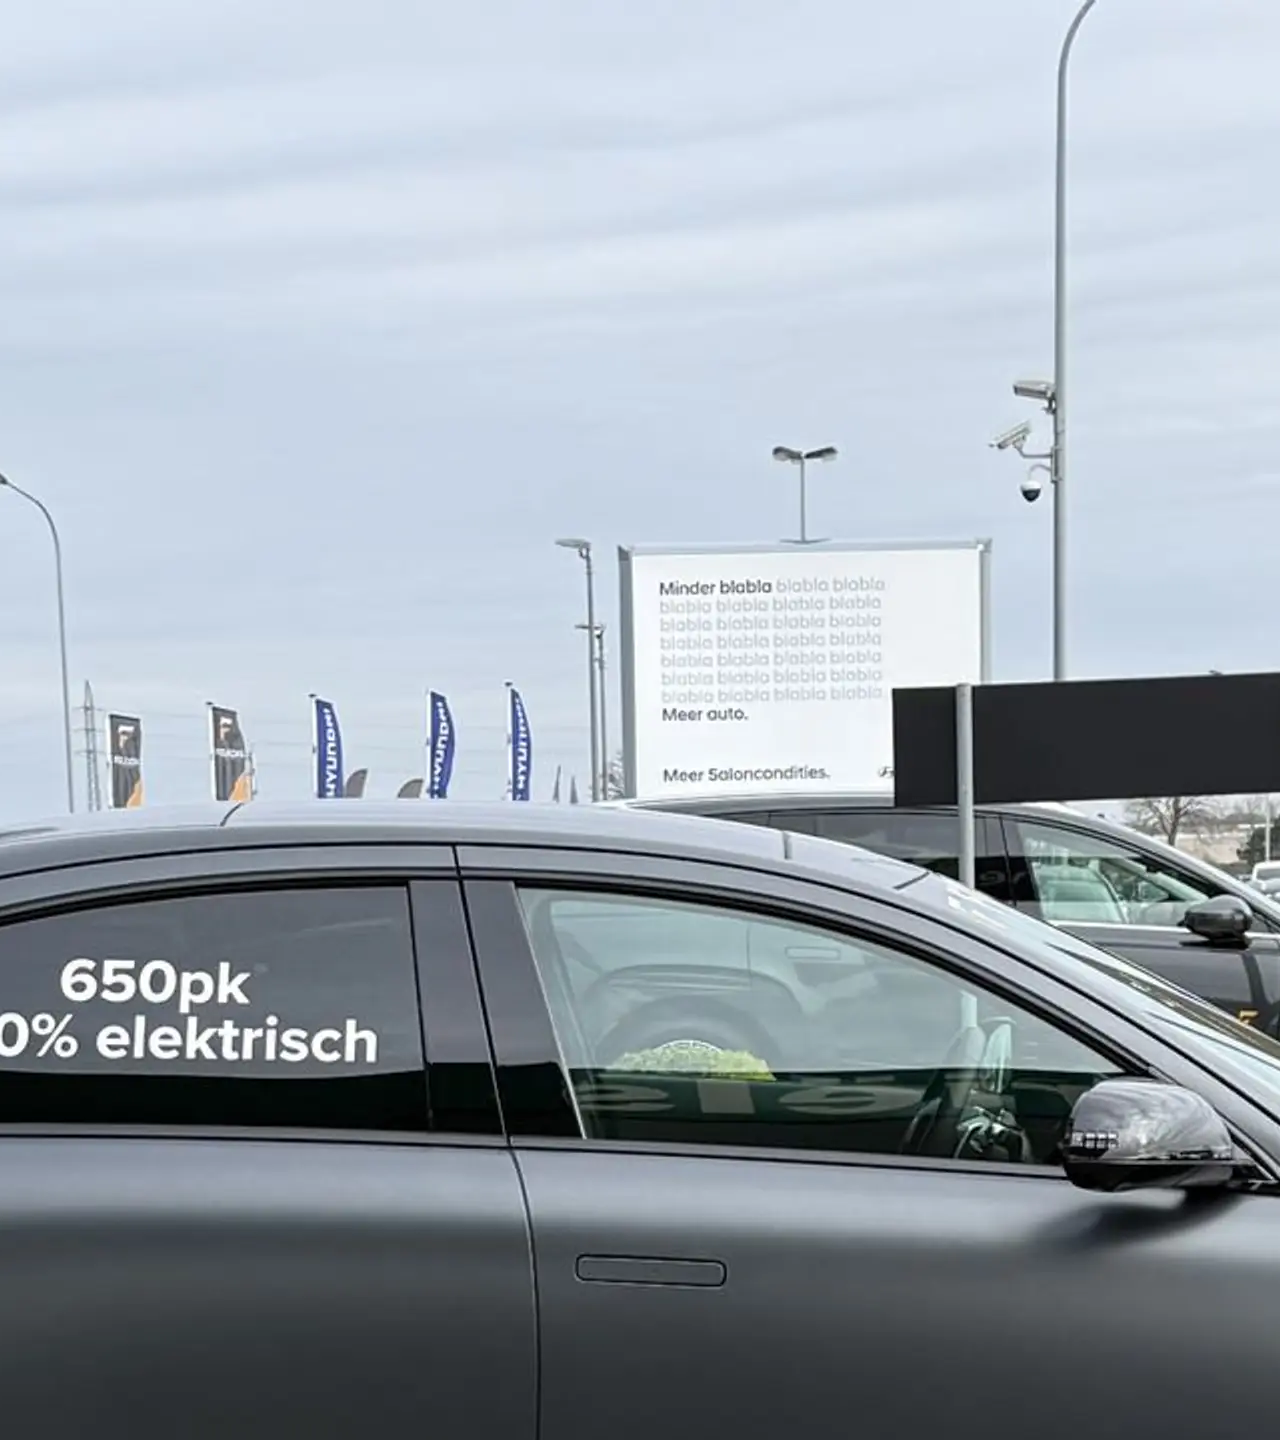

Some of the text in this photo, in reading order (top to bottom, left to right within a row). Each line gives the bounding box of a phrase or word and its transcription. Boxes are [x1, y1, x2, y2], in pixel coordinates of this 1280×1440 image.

[659, 575, 886, 596] Minder blabla blabla blabla
[659, 595, 881, 614] blabla blabla blabla blabla
[660, 613, 882, 632] blabla blabla blabla blabla
[660, 631, 882, 650] blabla blabla blabla blabla
[660, 650, 882, 668] blabla blabla blabla blabla
[661, 668, 883, 686] blabla blabla blabla blabla
[661, 686, 883, 704] blabla blabla blabla blabla
[662, 707, 749, 721] Meer auto.
[663, 764, 831, 782] Meer Saloncondities.
[60, 957, 252, 1014] 650pk
[96, 1014, 378, 1062] elektrisch
